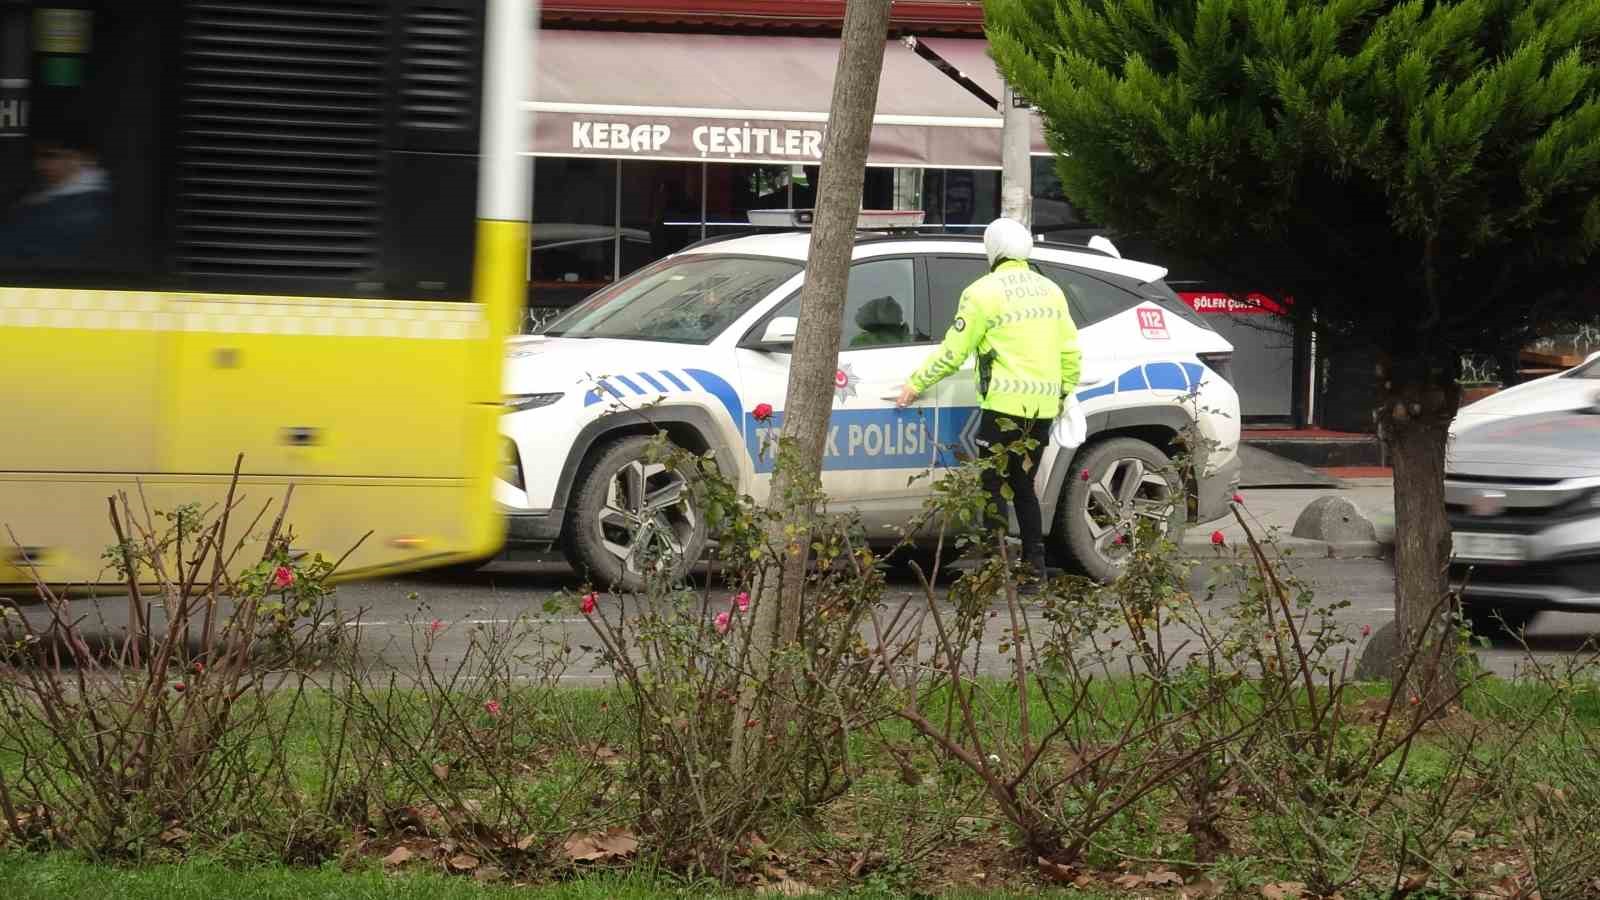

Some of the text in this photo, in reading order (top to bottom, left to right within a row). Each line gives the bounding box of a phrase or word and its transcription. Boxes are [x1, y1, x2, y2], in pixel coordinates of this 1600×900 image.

[572, 121, 828, 159] KEBAP ÇEŞİTLER
[1140, 311, 1165, 328] 112
[848, 417, 927, 457] POLİSİ
